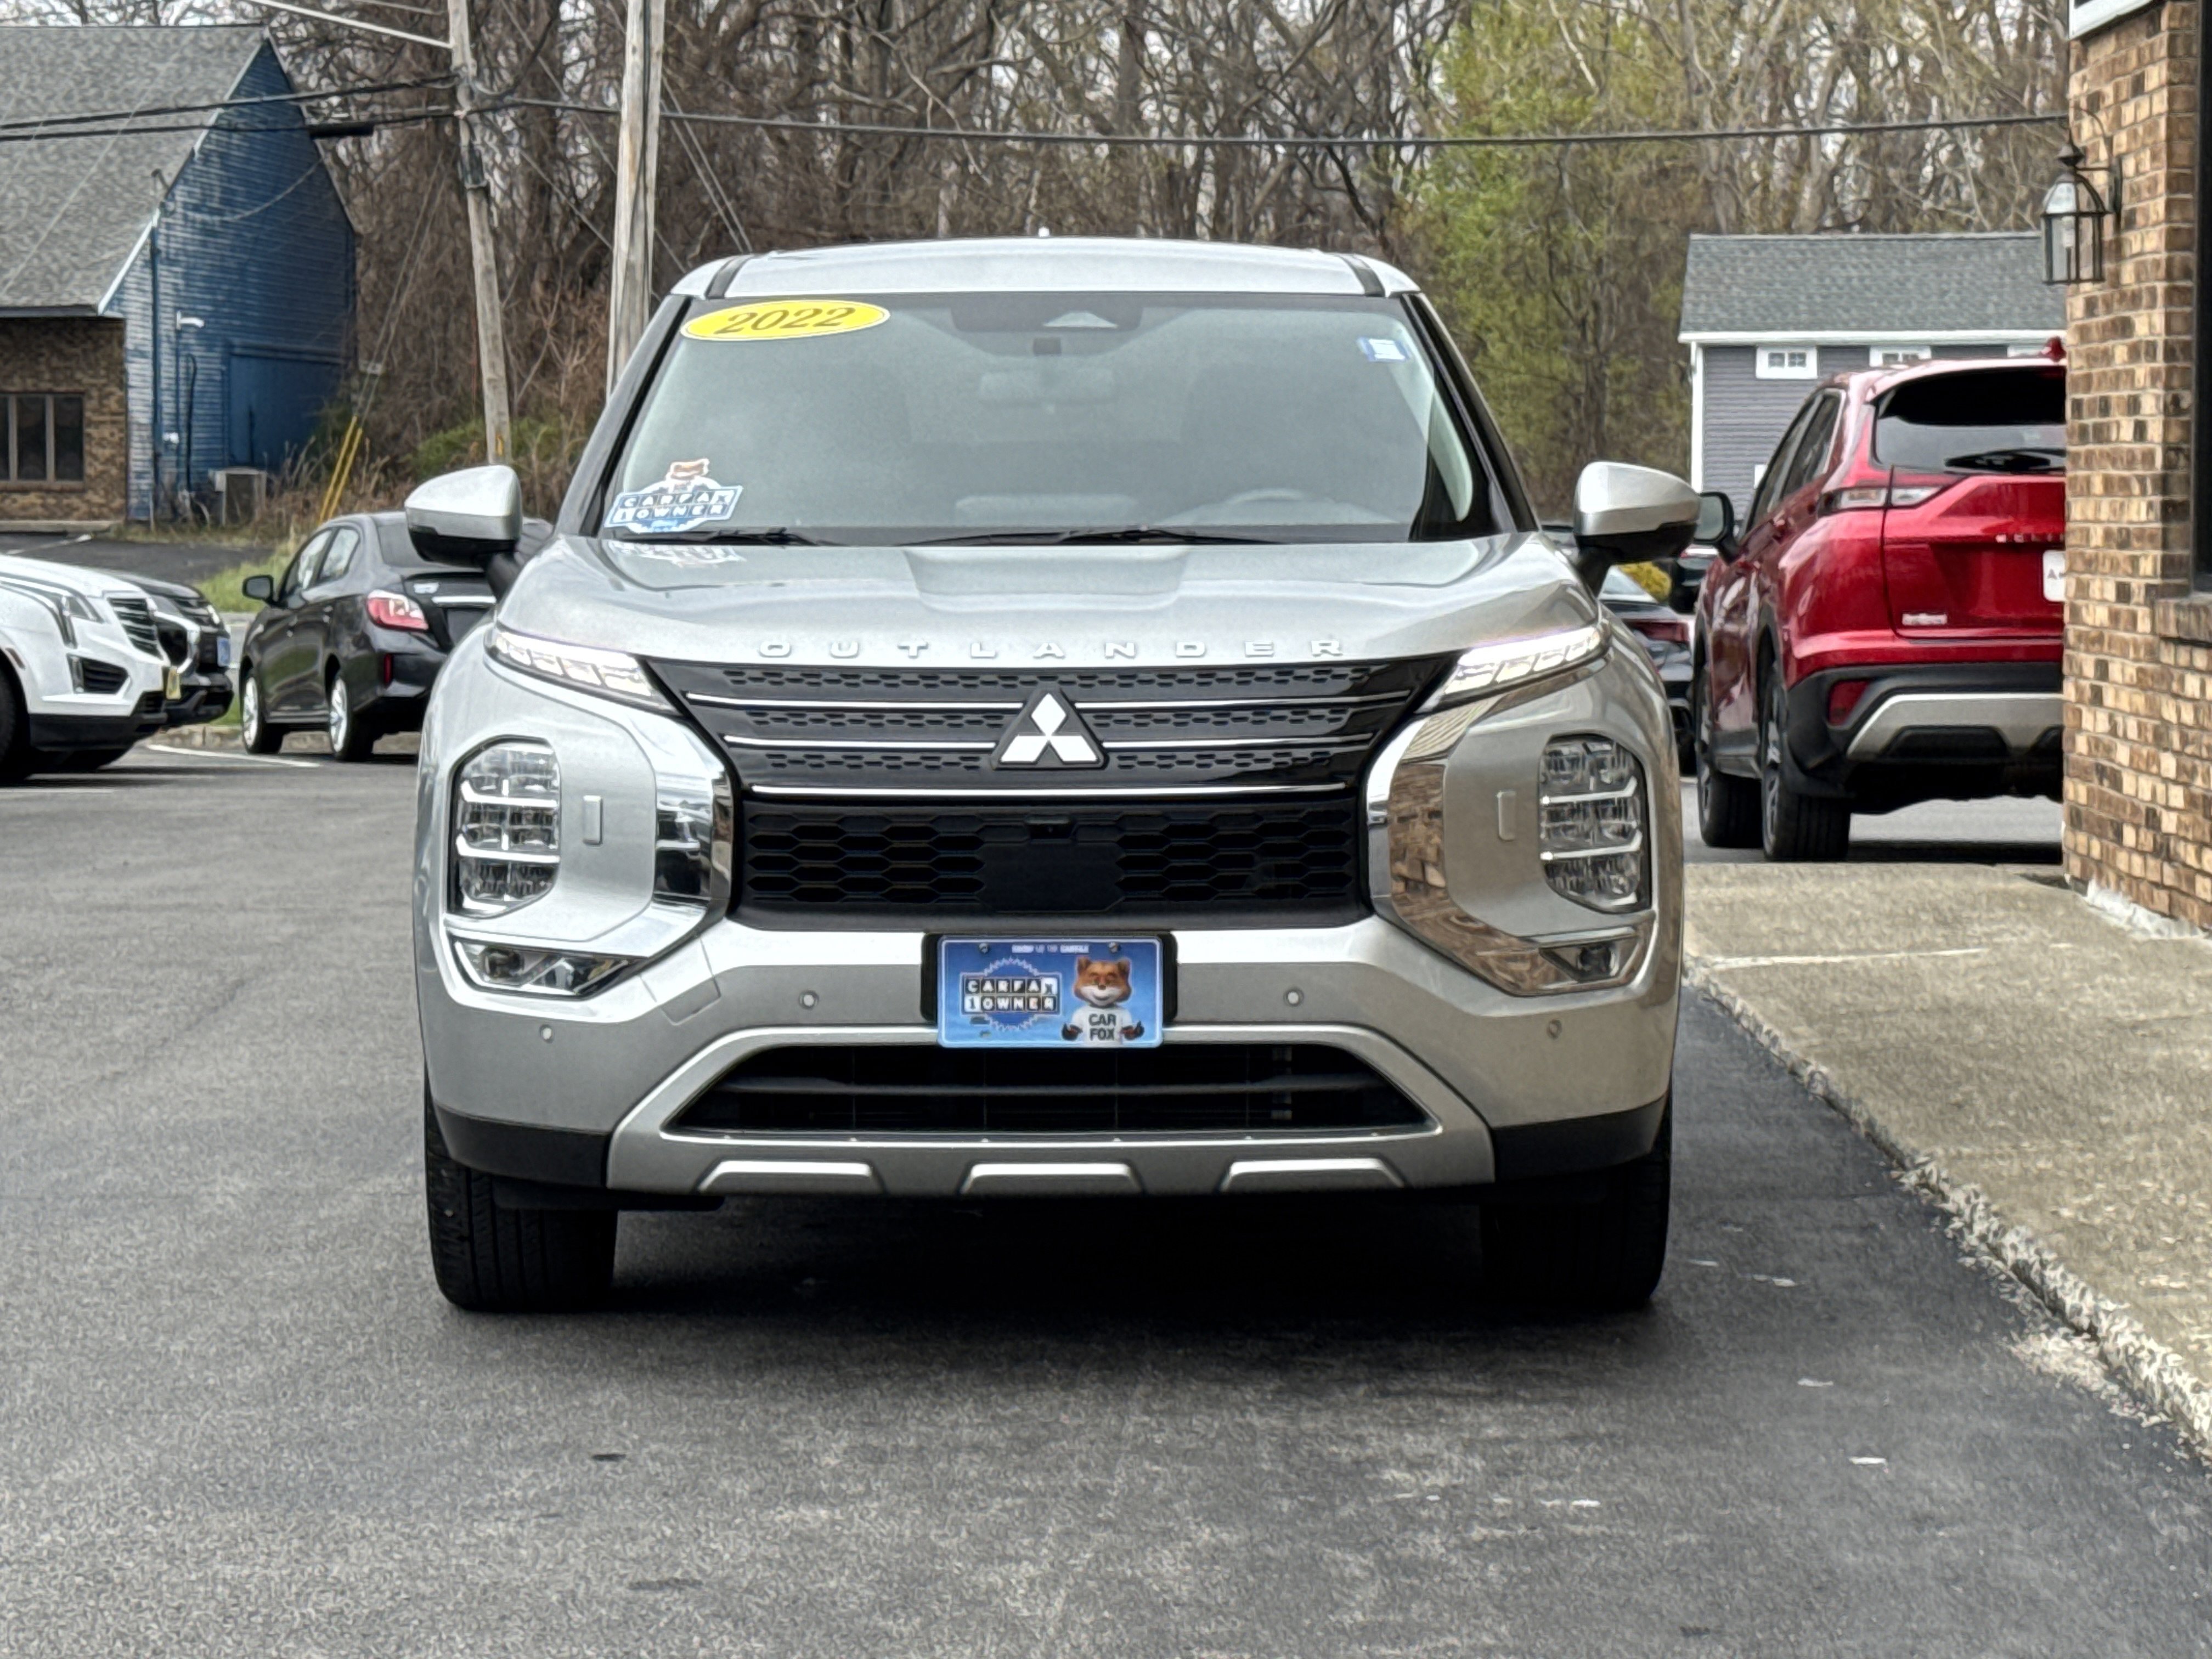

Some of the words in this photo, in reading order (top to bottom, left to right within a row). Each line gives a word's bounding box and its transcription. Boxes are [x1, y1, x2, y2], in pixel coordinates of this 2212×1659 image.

[713, 307, 856, 335] 2022
[636, 504, 725, 519] OWNER
[758, 640, 1344, 659] OUTLANDER
[968, 979, 1053, 994] CARFAX
[983, 997, 1054, 1010] OWNER
[1088, 1013, 1116, 1026] CAR
[1090, 1028, 1115, 1041] FOX
